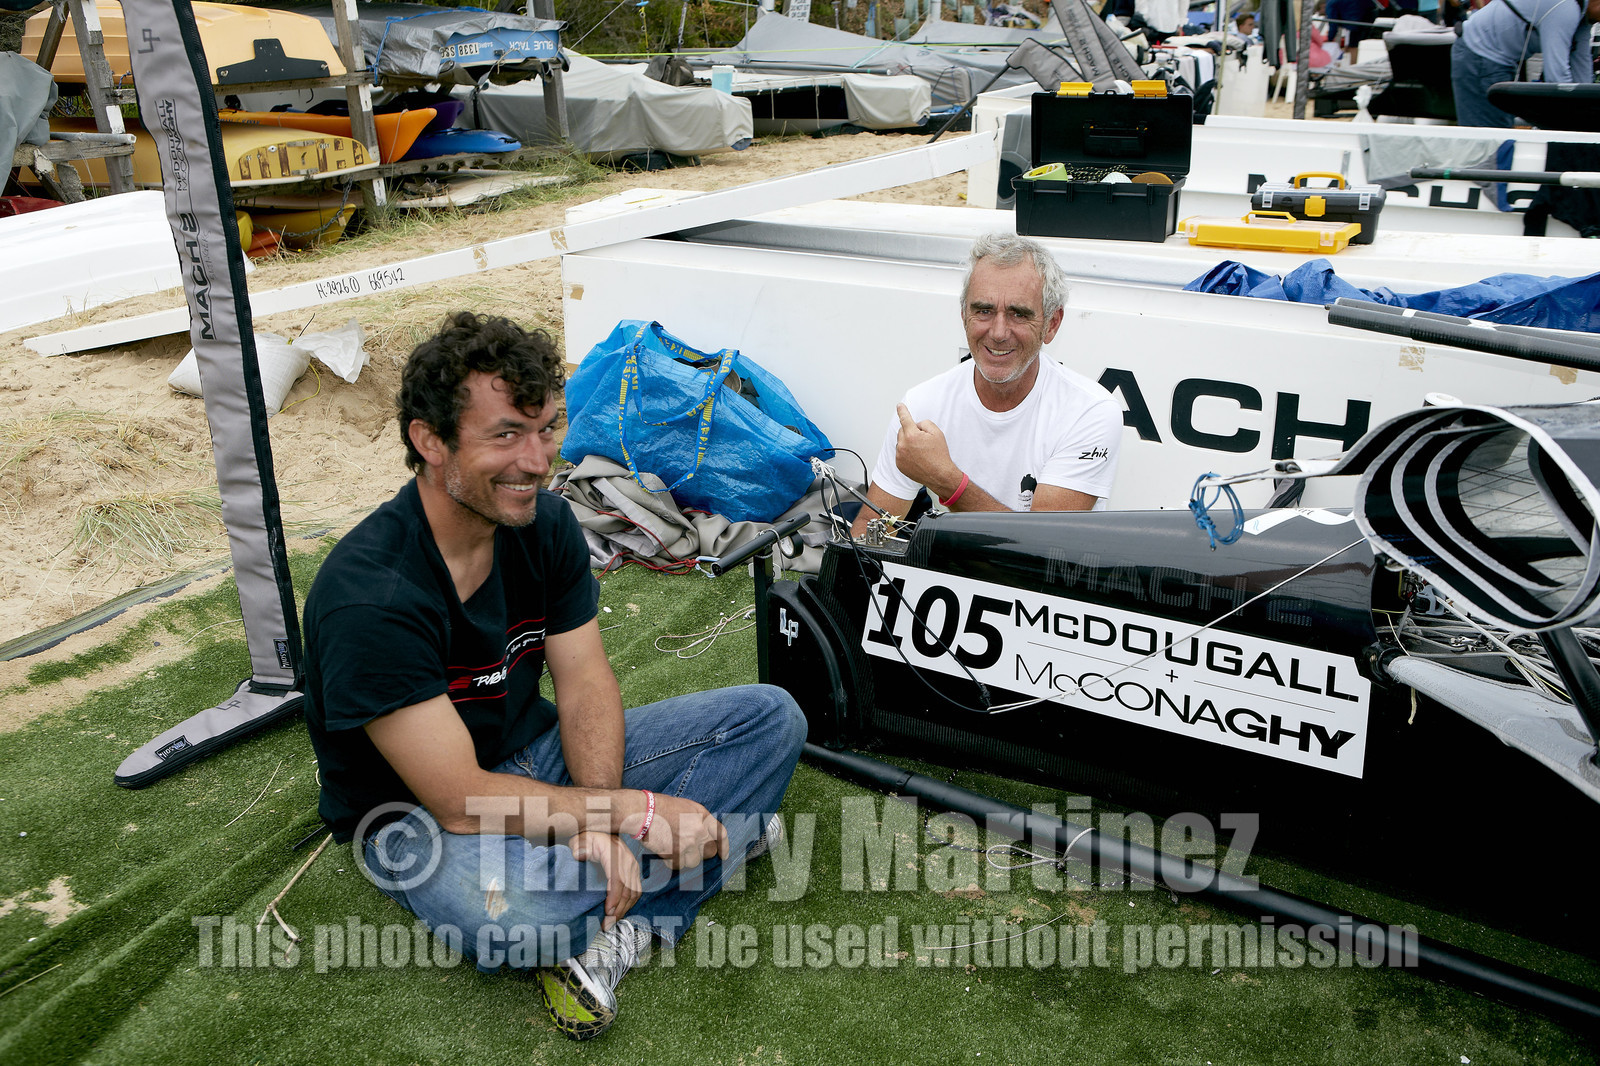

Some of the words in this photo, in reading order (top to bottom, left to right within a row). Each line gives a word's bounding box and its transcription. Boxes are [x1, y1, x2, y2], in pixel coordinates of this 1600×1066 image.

[458, 43, 478, 56] 1338
[509, 40, 531, 51] TACK
[533, 40, 554, 50] BLUE
[180, 212, 197, 233] 2
[186, 241, 214, 340] MACH
[1097, 367, 1372, 461] ACH
[1078, 446, 1108, 462] zhik
[866, 577, 1014, 670] 105
[1014, 599, 1360, 703] McDOUGALL
[1015, 653, 1357, 760] McCONAGHY
